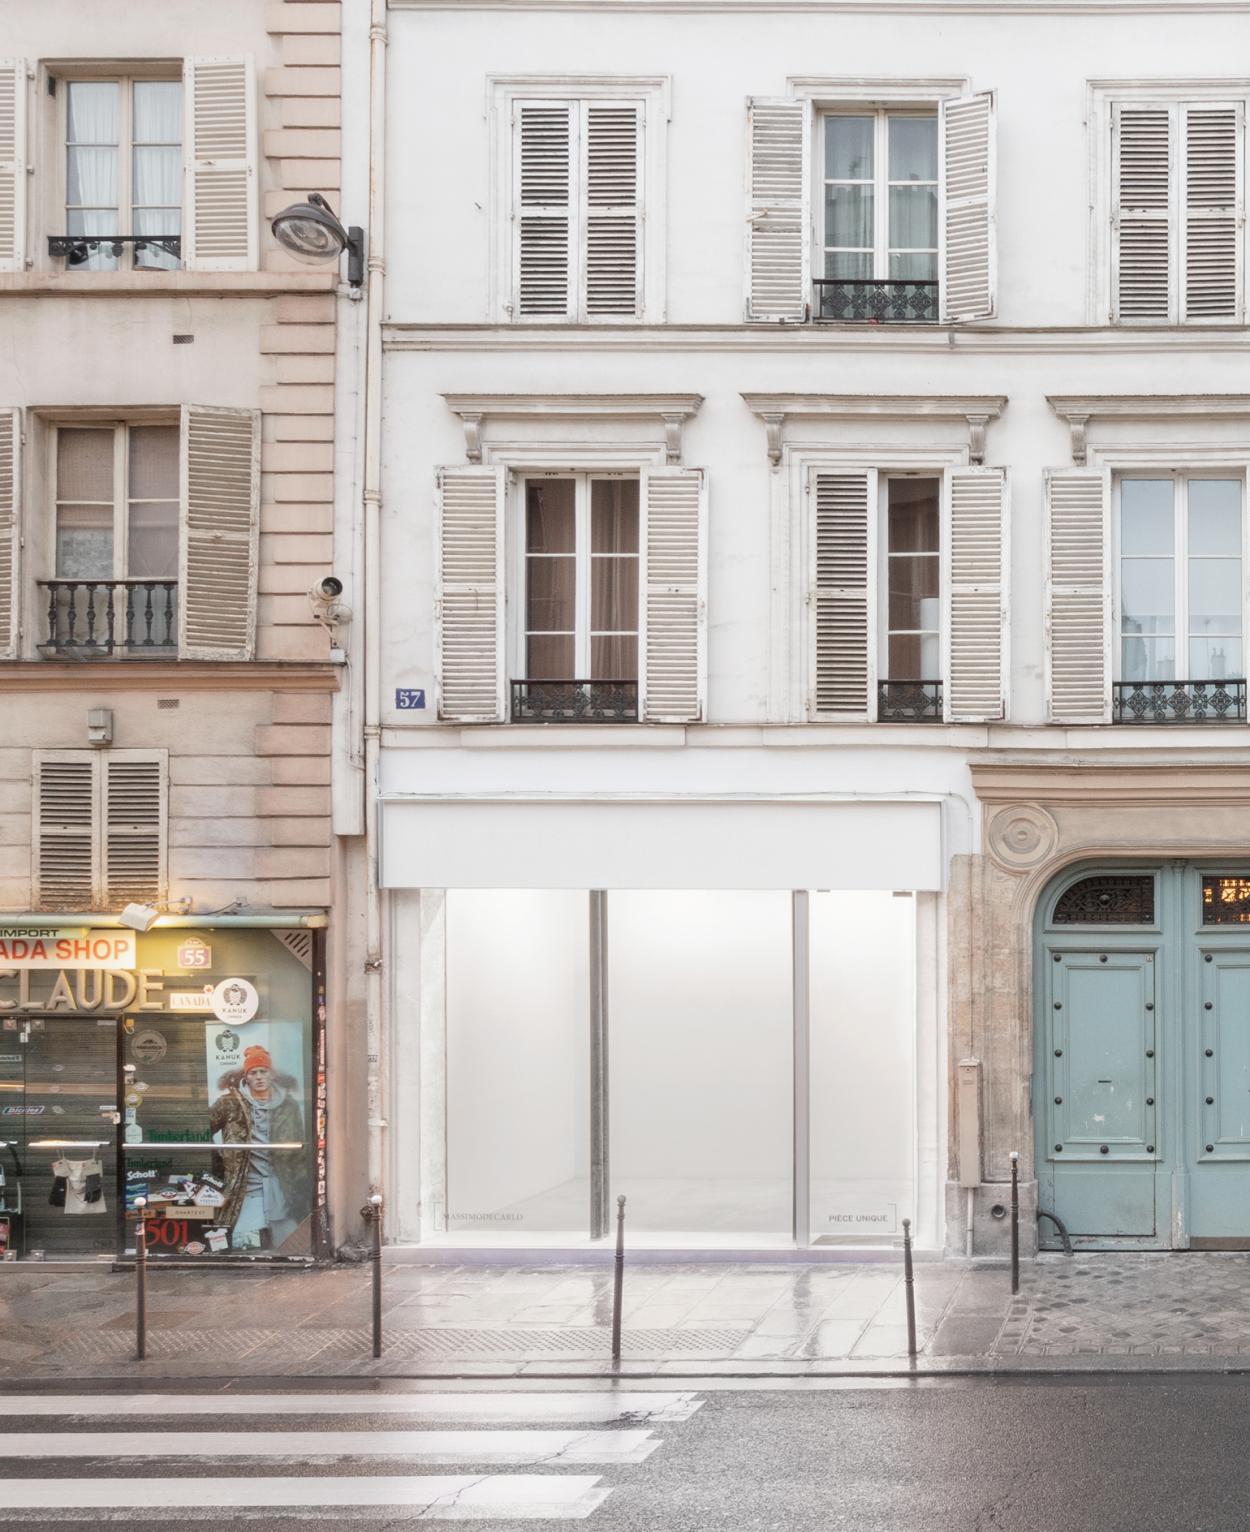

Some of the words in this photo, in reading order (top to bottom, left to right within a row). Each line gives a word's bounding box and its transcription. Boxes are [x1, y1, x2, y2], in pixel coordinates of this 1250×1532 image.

[400, 691, 421, 708] 57
[0, 929, 59, 938] IMPORT
[55, 939, 128, 960] SHOP
[183, 949, 205, 966] 55
[127, 1169, 156, 1181] Schott
[856, 1214, 888, 1222] UNIQUE
[145, 1218, 188, 1247] 501
